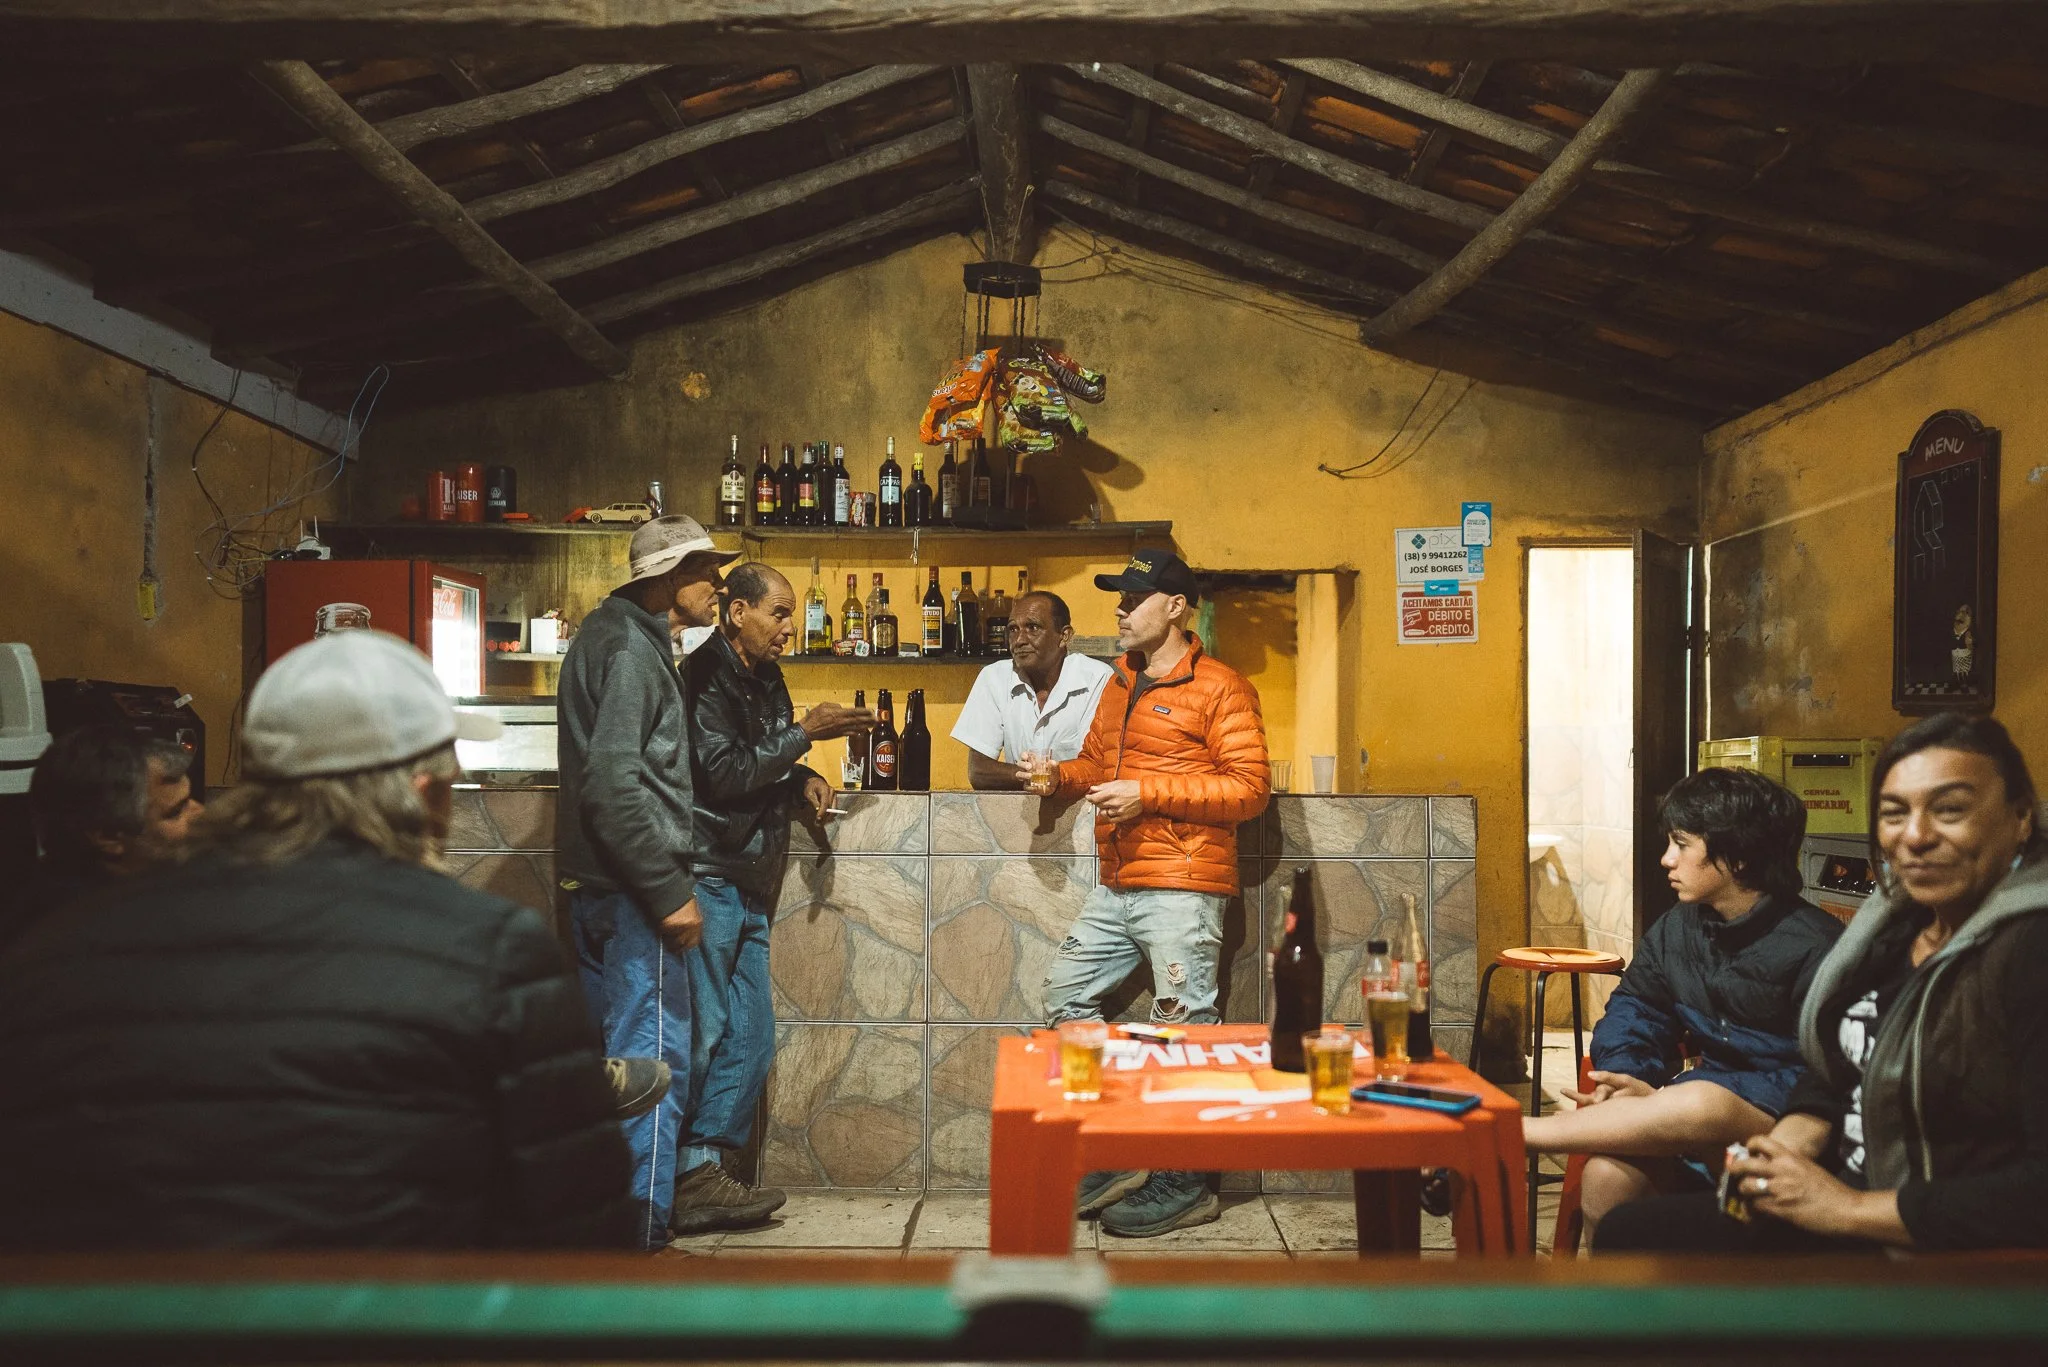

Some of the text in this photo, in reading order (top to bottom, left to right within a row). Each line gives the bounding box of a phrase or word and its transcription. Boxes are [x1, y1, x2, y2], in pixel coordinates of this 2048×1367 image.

[1925, 437, 1965, 462] MENU
[457, 489, 478, 501] AISER
[1429, 533, 1457, 549] pix
[1404, 550, 1468, 561] (38) 9 99412262
[1409, 564, 1464, 573] JOSÉ BORGES
[1403, 599, 1444, 608] ACEITAMOS
[1428, 607, 1472, 621] DÉBITO E
